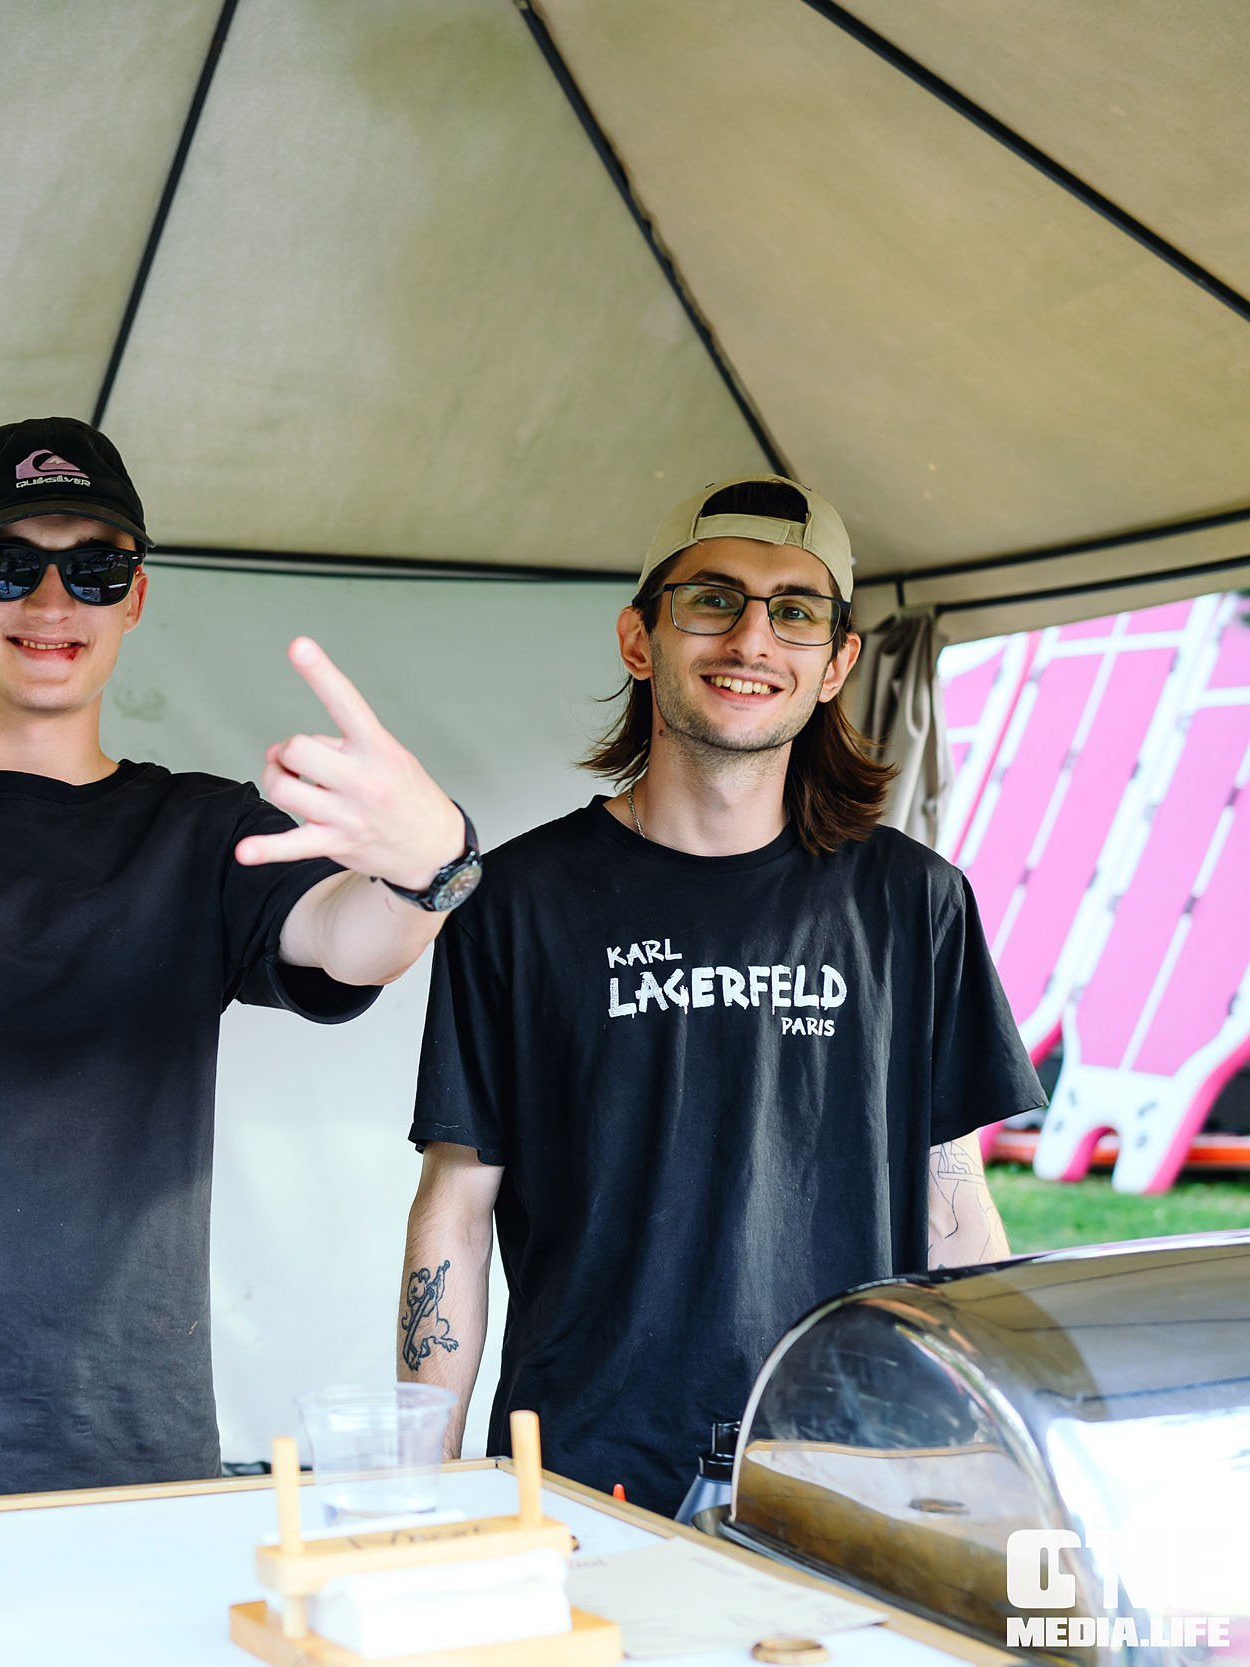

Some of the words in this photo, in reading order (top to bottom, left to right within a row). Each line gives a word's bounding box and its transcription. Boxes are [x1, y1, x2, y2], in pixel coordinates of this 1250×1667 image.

[607, 938, 682, 968] KARL
[608, 964, 848, 1018] LAGERFELD
[781, 1017, 835, 1037] PARIS
